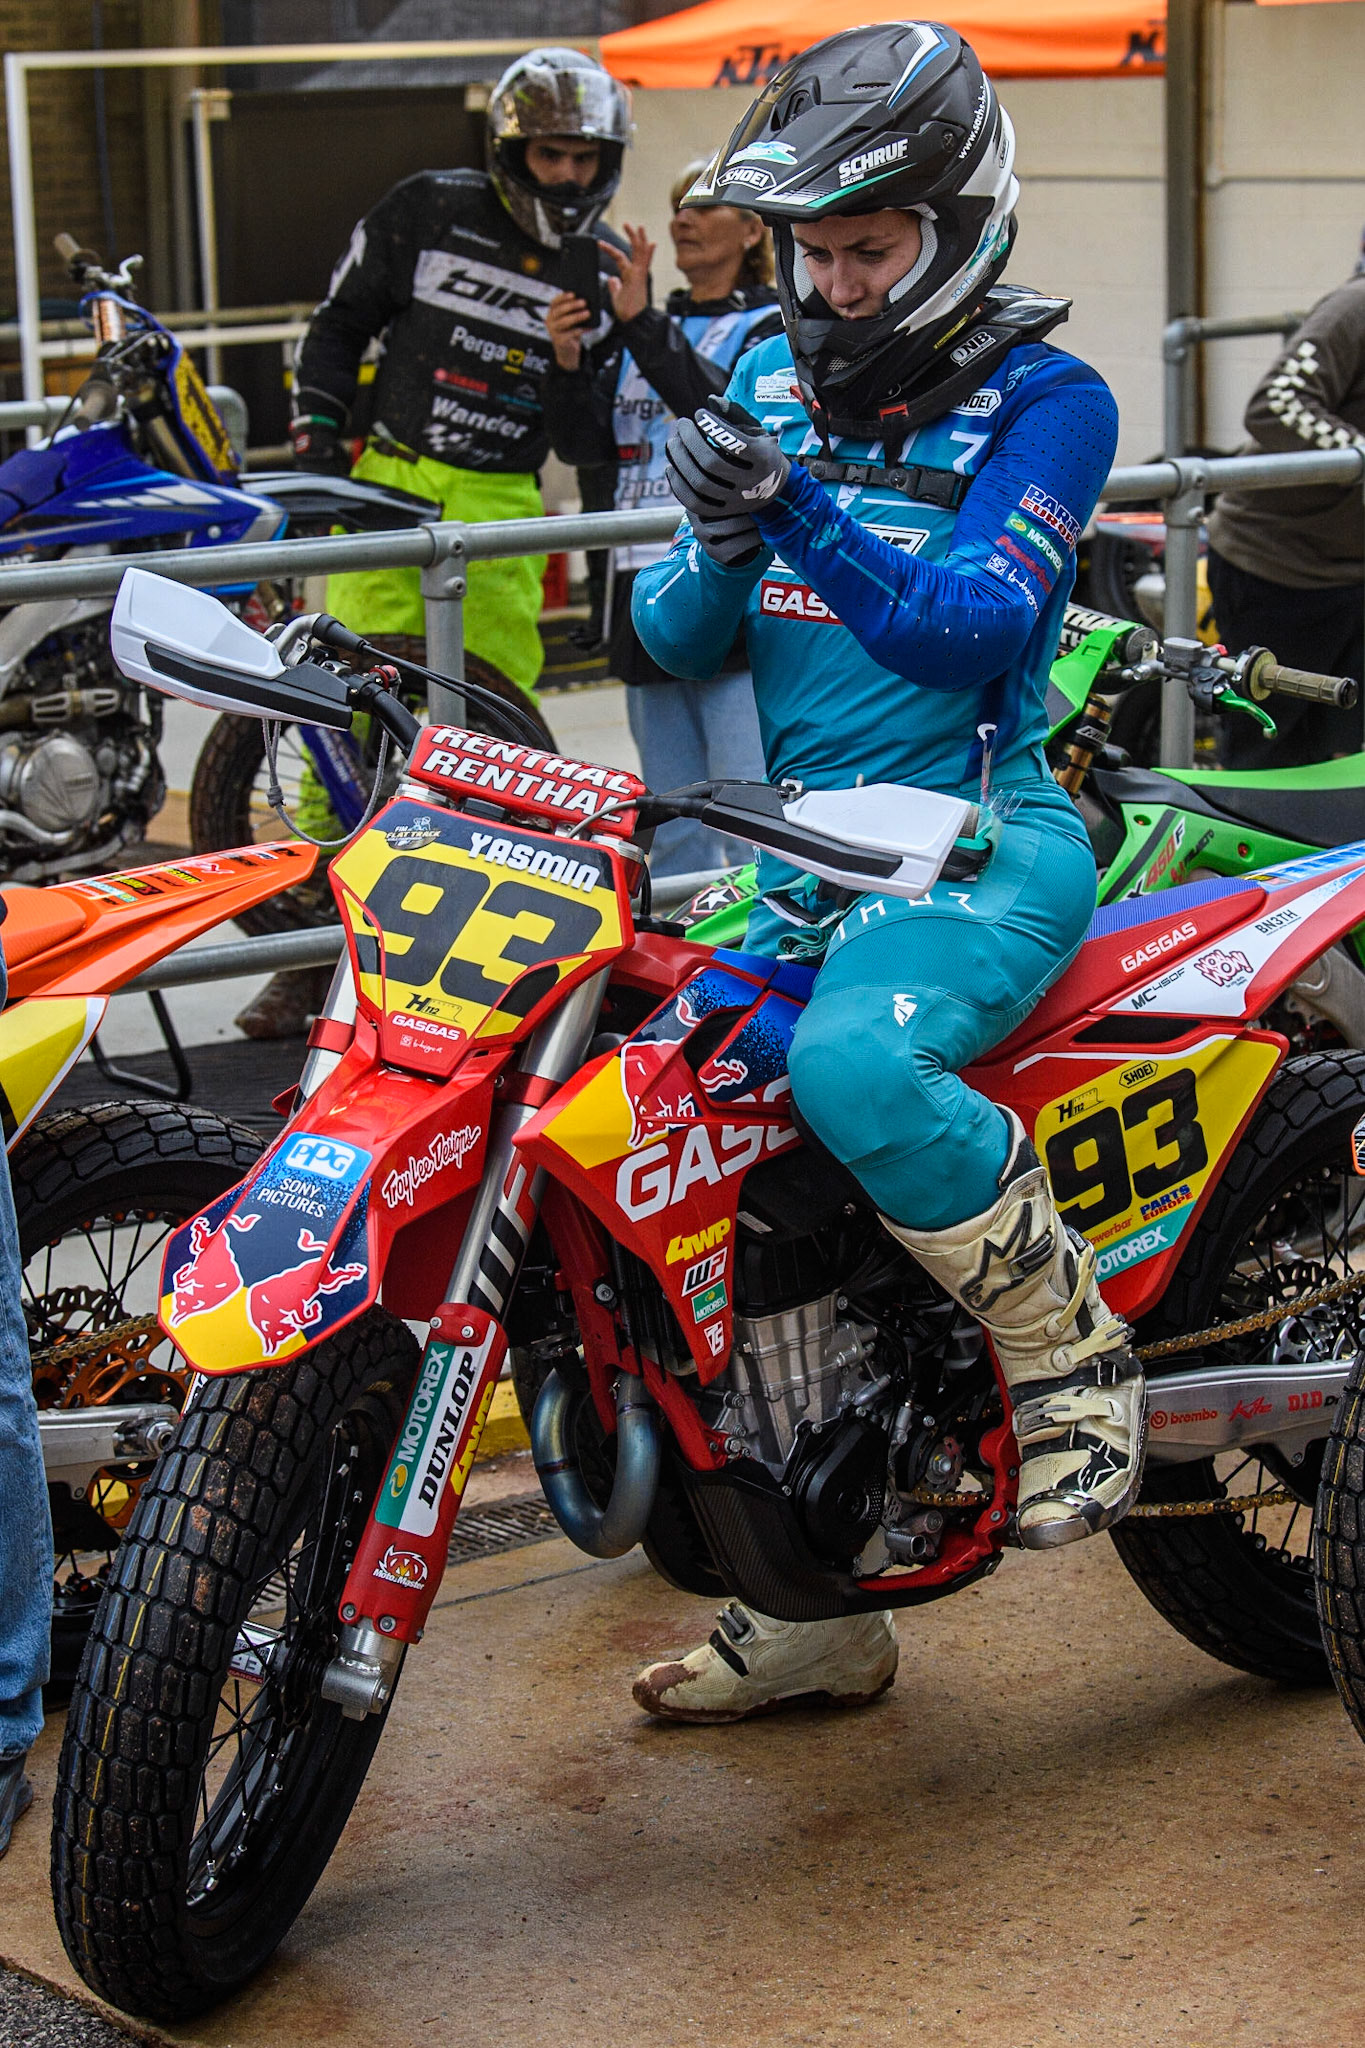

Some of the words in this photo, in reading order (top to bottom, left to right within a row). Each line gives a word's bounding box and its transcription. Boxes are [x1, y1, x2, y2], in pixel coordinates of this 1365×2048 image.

[839, 139, 908, 178] SCHRUF
[721, 168, 770, 189] SHOEI
[840, 173, 865, 187] RACING
[951, 272, 977, 301] sachs
[432, 396, 528, 439] Wander
[697, 413, 748, 456] THOR
[431, 727, 633, 795] RENTHAL
[422, 749, 624, 823] RENTHAL
[386, 831, 410, 839] FLAT
[411, 830, 442, 838] TRACK
[468, 832, 601, 893] YASMIN
[363, 855, 603, 1008] 93
[1254, 909, 1298, 934] BN3TH
[1120, 921, 1198, 974] GASGAS
[1131, 967, 1186, 1011] MC450F
[391, 1014, 461, 1041] GASGAS
[1123, 1063, 1154, 1086] SHOEI
[290, 1142, 350, 1173] PPG
[429, 1125, 482, 1171] Designs
[1045, 1068, 1209, 1234] 93
[257, 1187, 327, 1219] PICTURES
[280, 1177, 321, 1198] SONY
[1139, 1183, 1191, 1216] PARTS
[1142, 1192, 1193, 1222] EUROPE
[665, 1217, 731, 1266] 4WP
[685, 1256, 726, 1292] WP
[696, 1296, 726, 1319] MOTOREX
[397, 1347, 449, 1463] MOTOREX
[1170, 1407, 1218, 1425] brembo
[418, 1351, 475, 1510] DUNLOP
